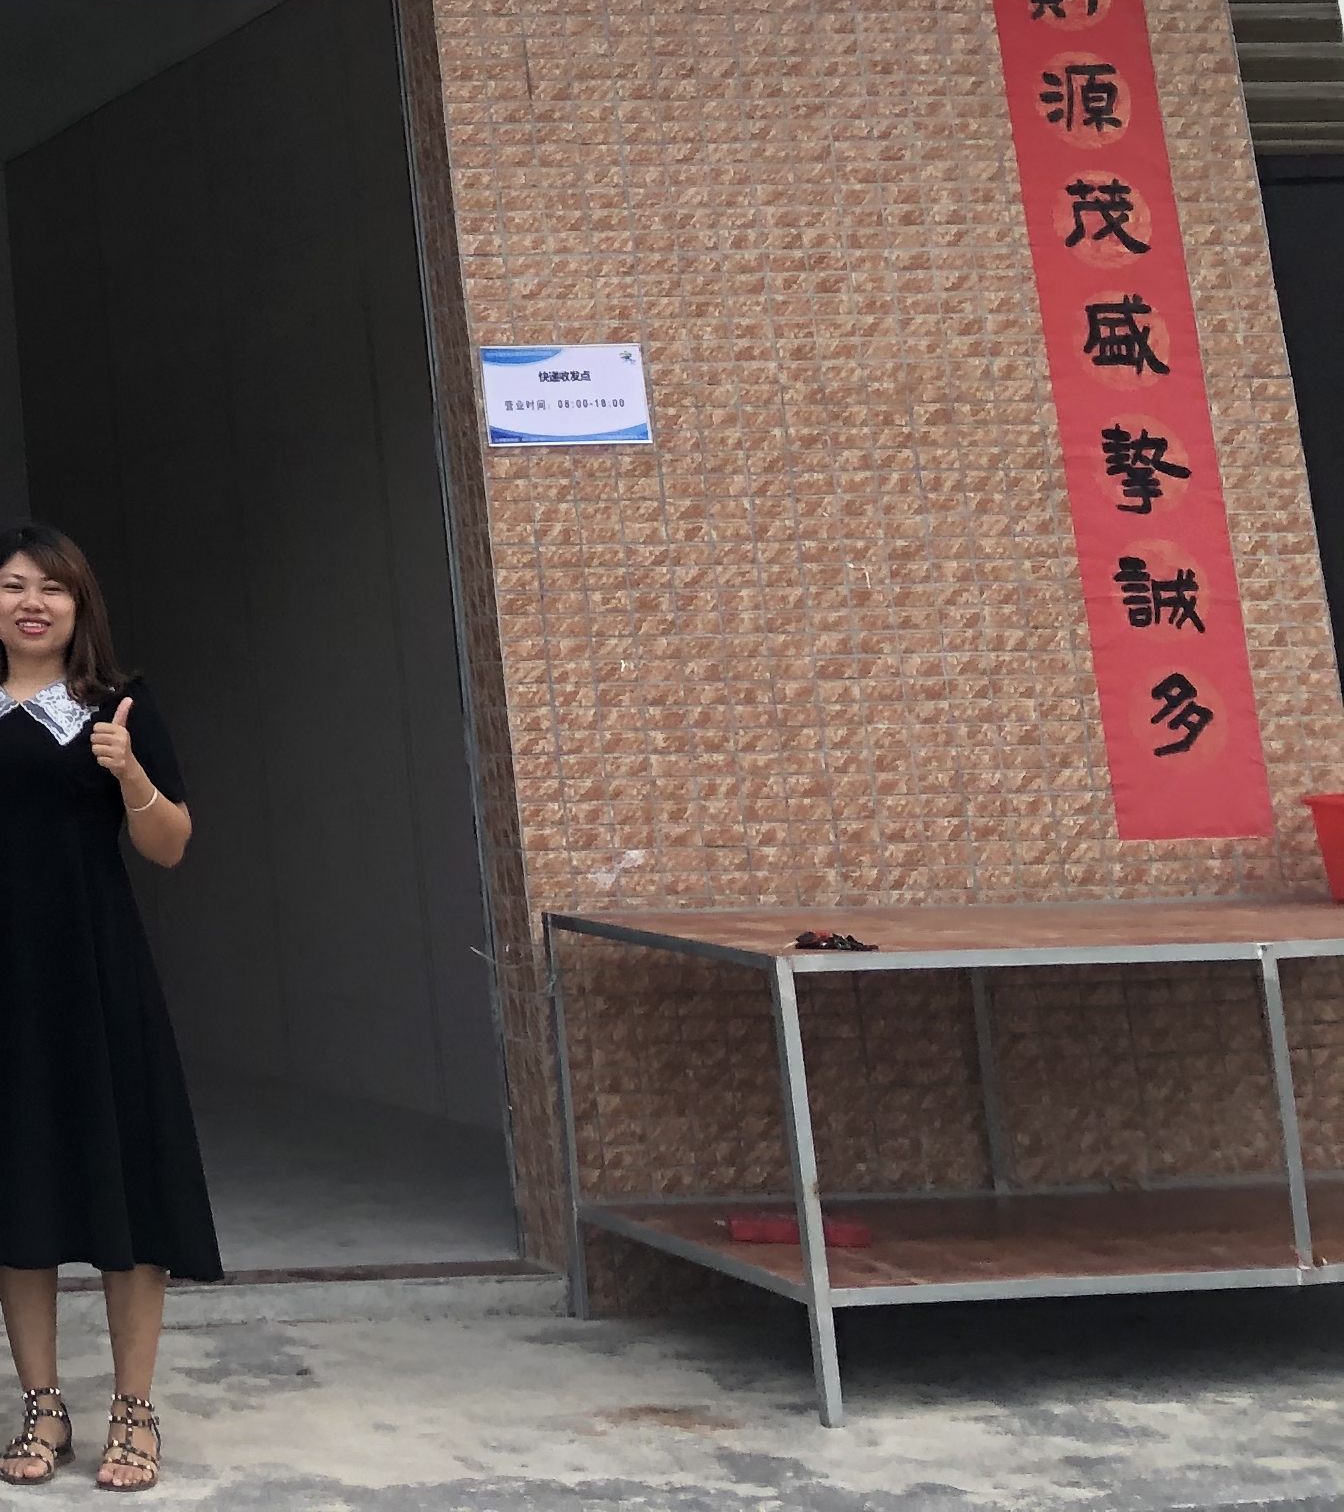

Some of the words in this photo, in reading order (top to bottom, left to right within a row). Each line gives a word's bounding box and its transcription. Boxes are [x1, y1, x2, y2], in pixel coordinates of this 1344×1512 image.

[538, 370, 592, 383] 快递收发点
